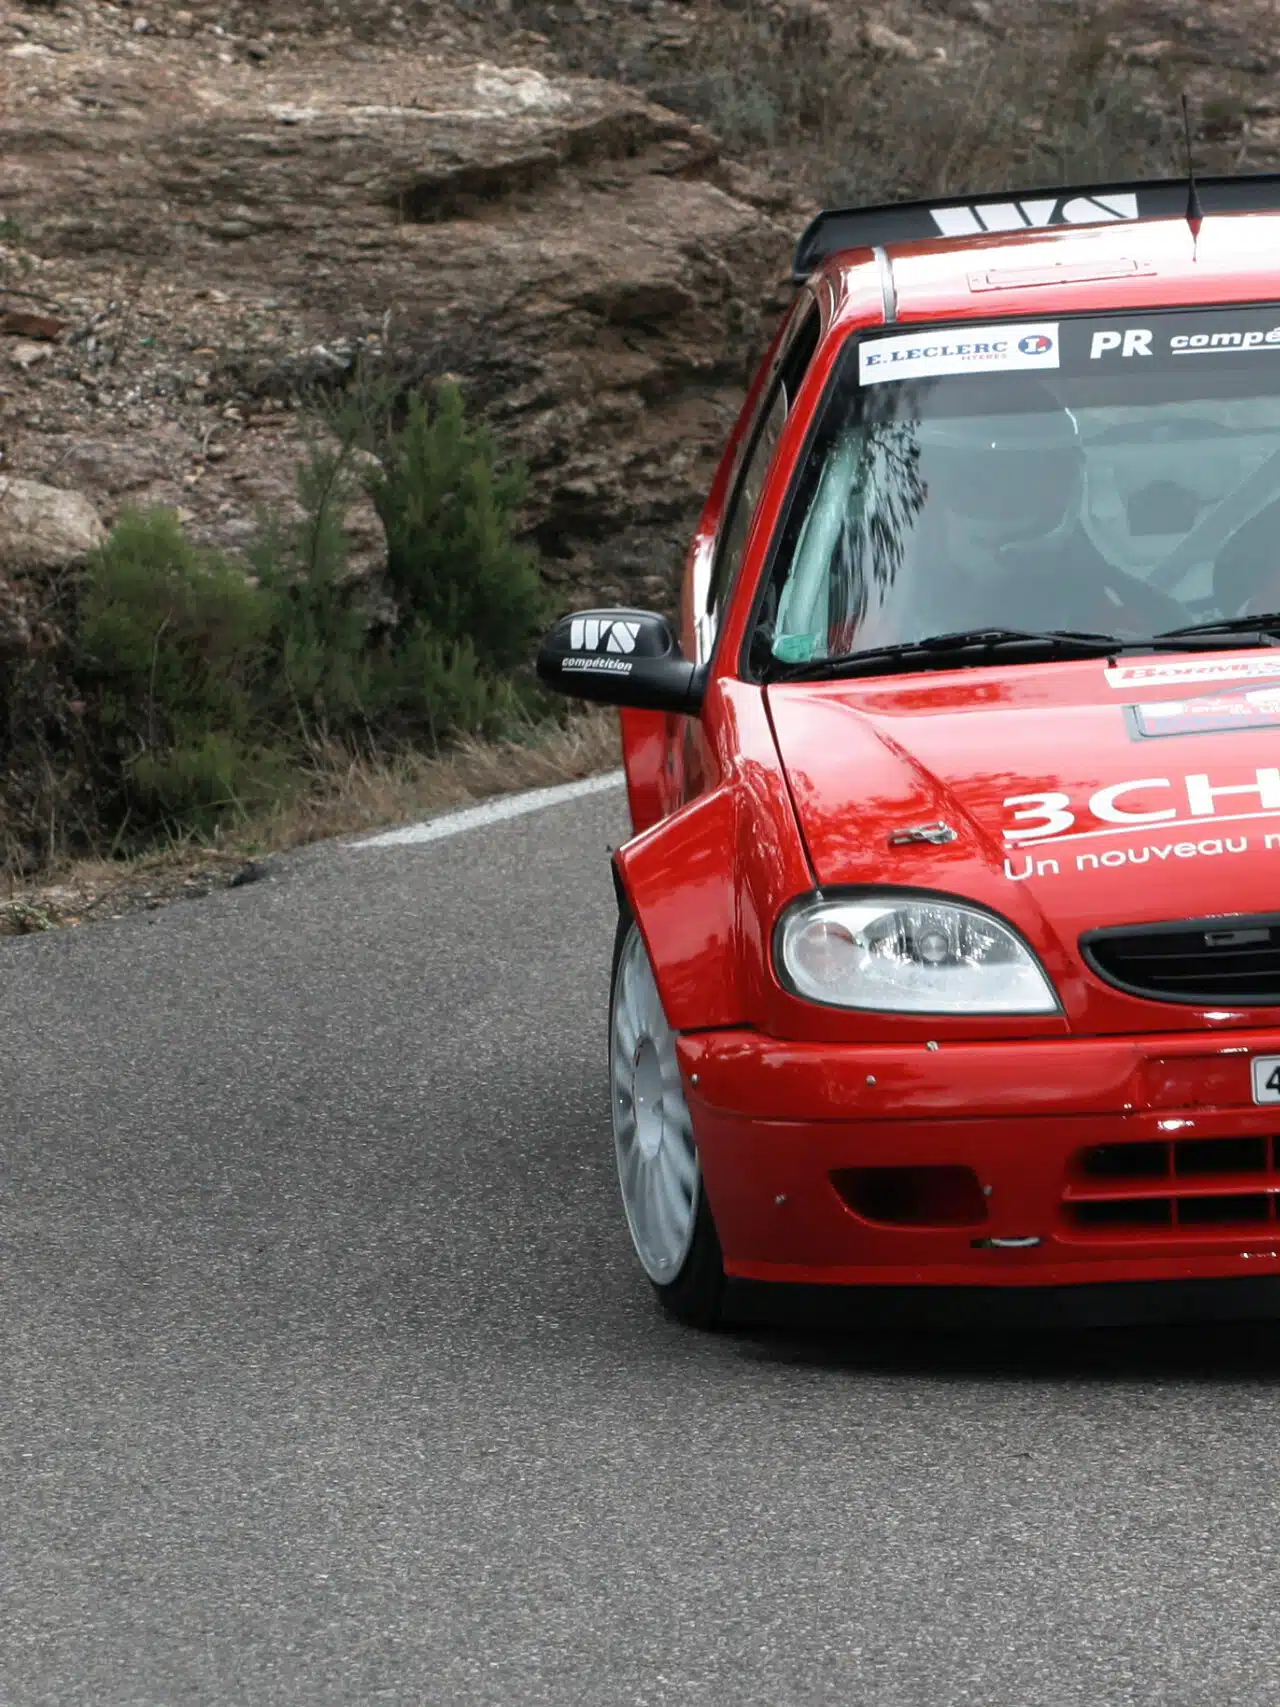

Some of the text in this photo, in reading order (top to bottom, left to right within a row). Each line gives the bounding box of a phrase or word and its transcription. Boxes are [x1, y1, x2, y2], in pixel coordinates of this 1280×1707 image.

[866, 341, 1008, 366] E.LECLERC
[1090, 329, 1153, 359] PR
[562, 657, 633, 671] compétition
[1003, 855, 1060, 880] Un
[1076, 836, 1248, 871] nouveau
